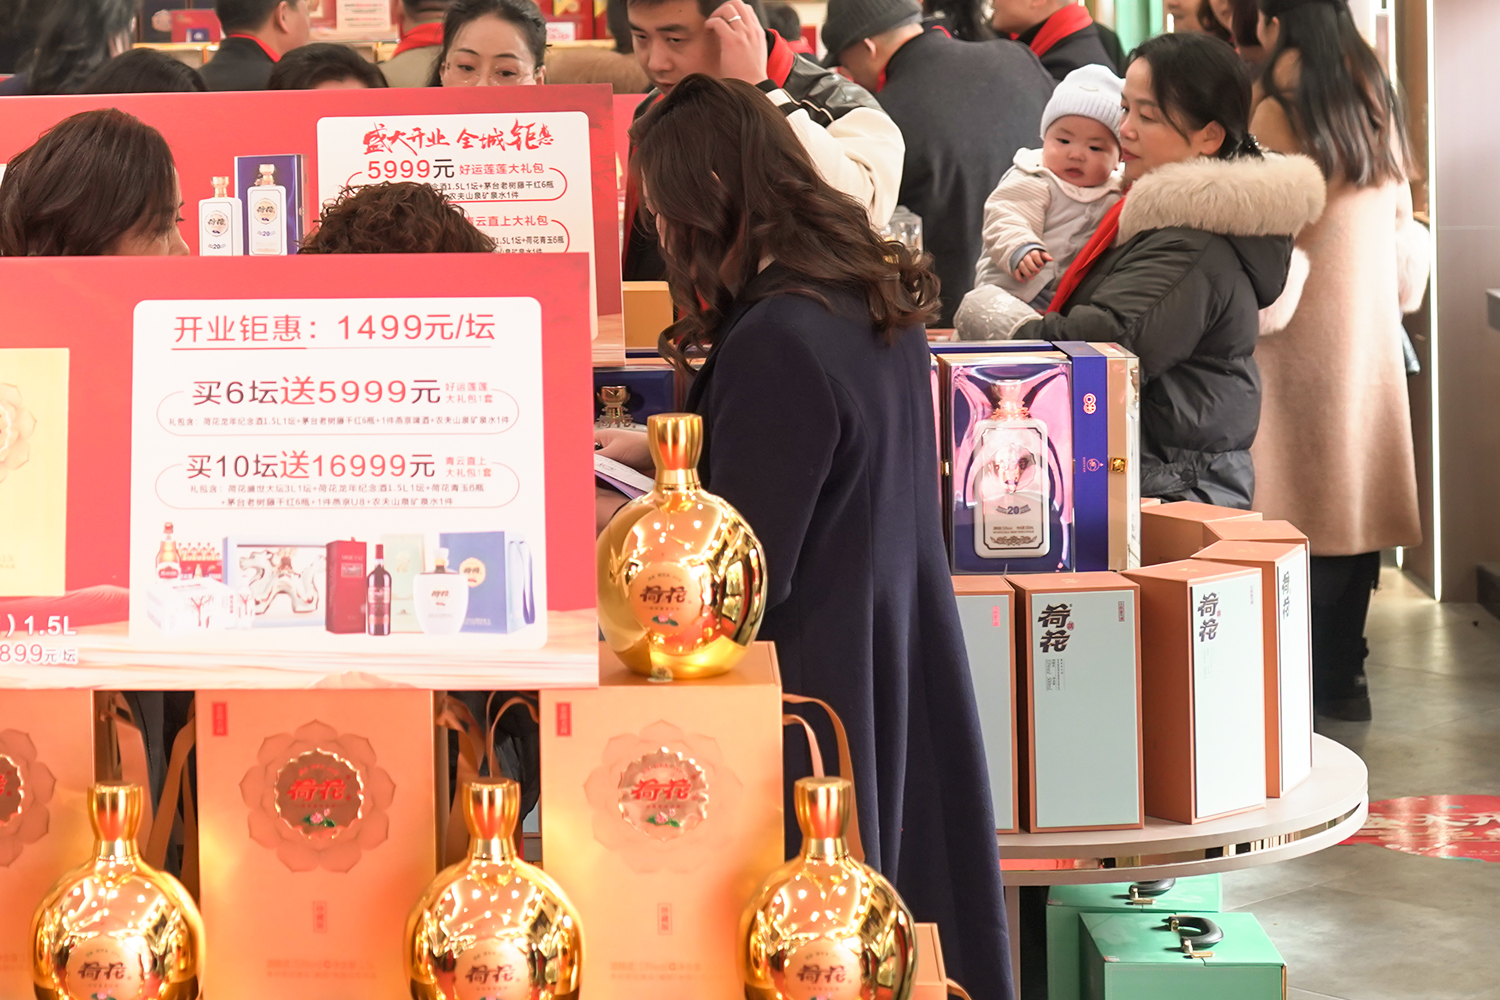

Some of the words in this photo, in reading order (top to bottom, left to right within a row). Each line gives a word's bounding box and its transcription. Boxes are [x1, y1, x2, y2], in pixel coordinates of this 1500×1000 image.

[363, 122, 451, 156] 盛大开业
[456, 117, 554, 152] 全城钜惠
[367, 158, 455, 180] 5999元
[173, 313, 497, 344] 开业钜惠：1499元/坛
[192, 375, 441, 406] 买6坛送5999元
[186, 450, 436, 481] 买10坛送16999元
[1008, 505, 1020, 515] 20
[640, 584, 688, 604] 荷花
[1037, 603, 1072, 654] 荷花
[1197, 592, 1220, 643] 荷花
[287, 778, 347, 801] 荷花
[631, 778, 692, 801] 荷花
[77, 961, 127, 981] 荷花
[465, 964, 515, 983] 荷花
[796, 964, 847, 984] 荷花
